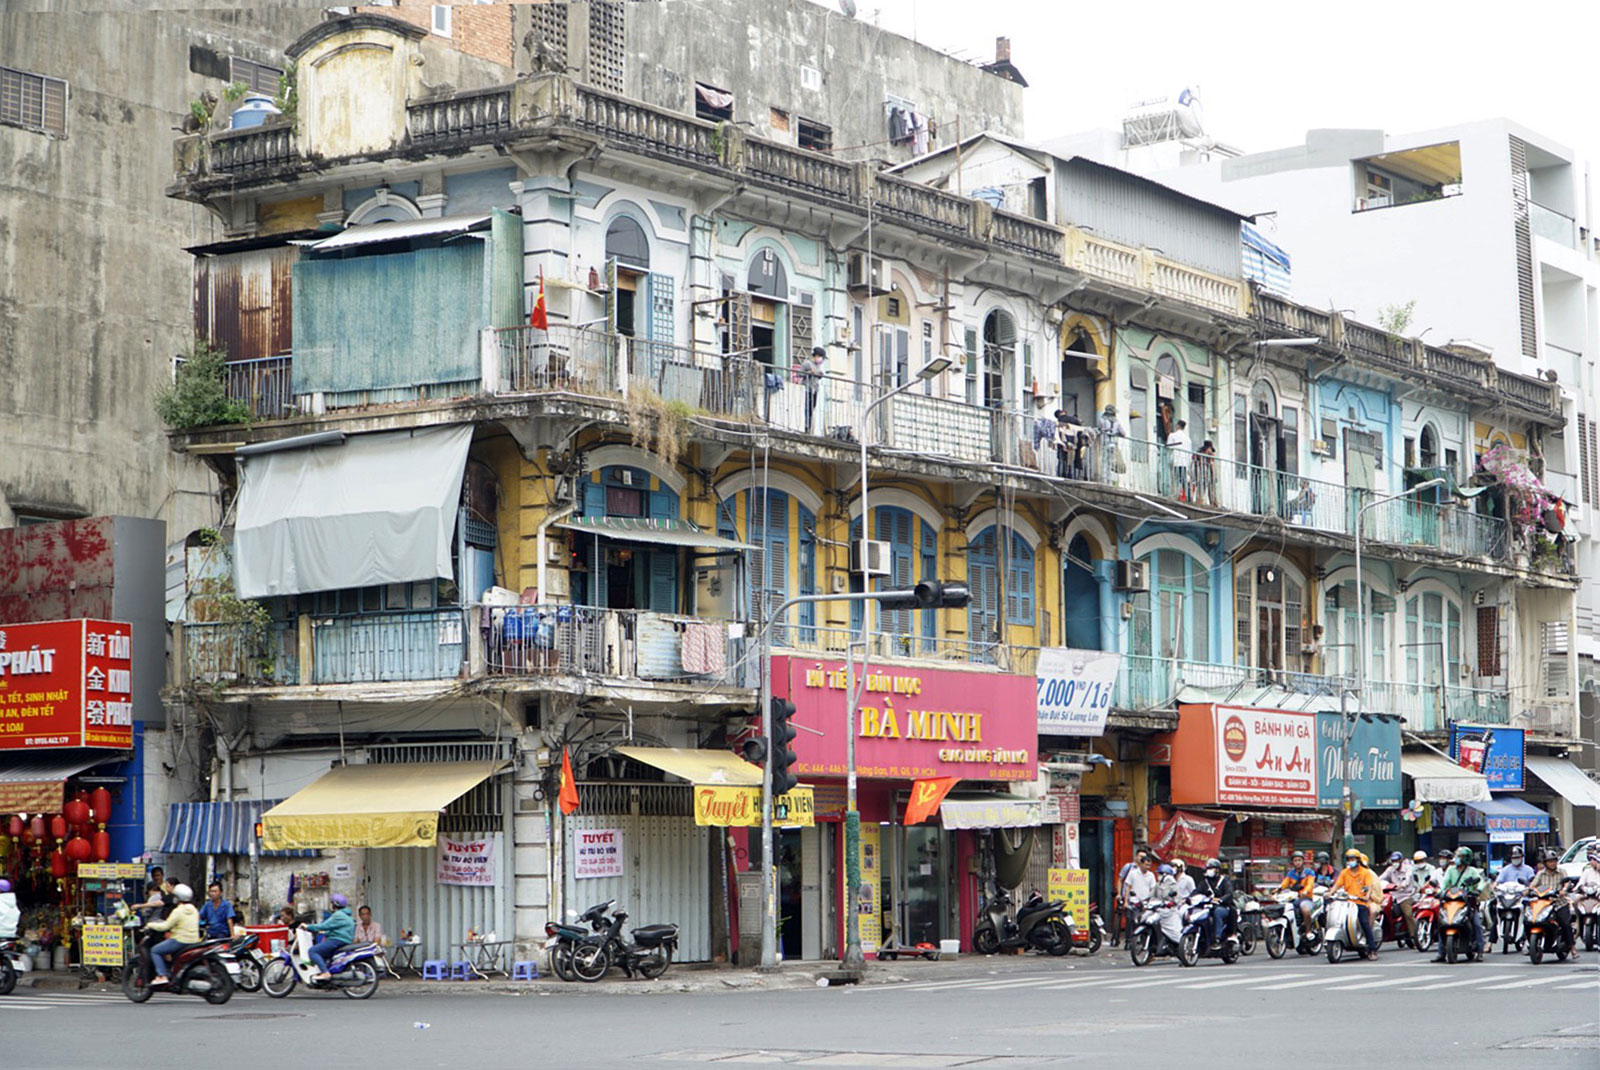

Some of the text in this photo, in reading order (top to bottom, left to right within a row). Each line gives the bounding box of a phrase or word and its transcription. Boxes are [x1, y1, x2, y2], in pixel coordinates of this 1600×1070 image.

[87, 632, 106, 656] 新
[0, 645, 56, 675] PHÁT
[87, 666, 106, 690] 金
[827, 665, 856, 690] TIẾ
[866, 670, 891, 693] BÚN
[893, 676, 921, 698] MỌC
[25, 692, 45, 702] SINH
[46, 689, 69, 702] NHẬT
[6, 723, 24, 734] LOẠI
[859, 697, 983, 742] BÀ MINH
[1255, 718, 1281, 736] BÁNH
[1284, 720, 1294, 737] MÌ
[1297, 721, 1310, 739] GÀ
[1255, 743, 1311, 773] An An
[700, 790, 749, 824] Tuyết
[794, 793, 813, 813] VIÊN
[447, 841, 486, 853] TUYẾT
[582, 831, 613, 843] TUYẾT
